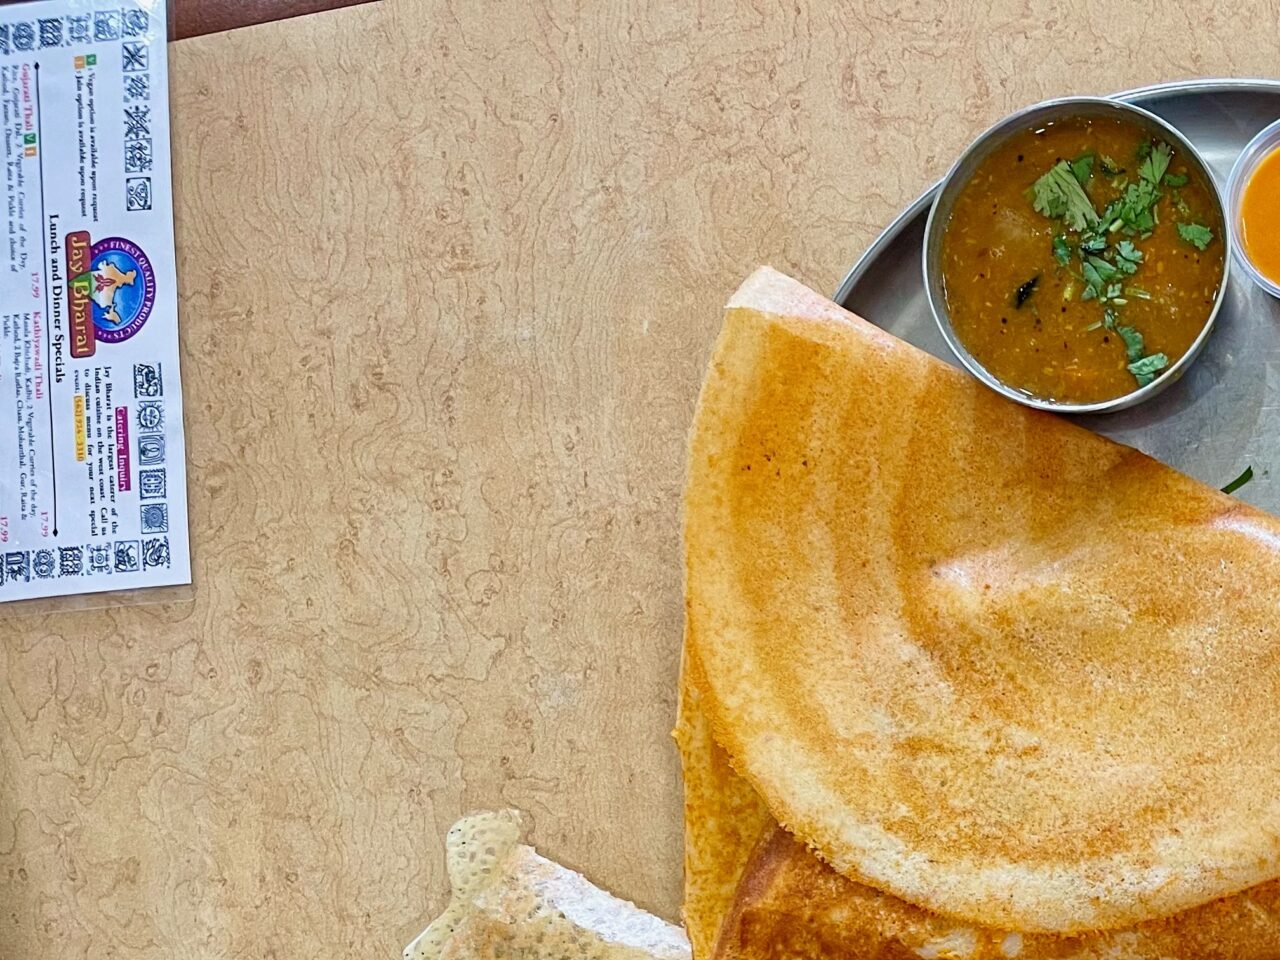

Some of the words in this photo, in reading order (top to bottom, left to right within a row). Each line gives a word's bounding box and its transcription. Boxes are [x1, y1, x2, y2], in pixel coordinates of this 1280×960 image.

[19, 64, 31, 102] Gujarati
[86, 73, 96, 96] Vegan
[24, 105, 33, 131] Thali
[75, 93, 84, 119] option
[87, 99, 96, 124] option
[90, 136, 98, 168] available
[89, 171, 97, 191] upon
[78, 189, 87, 216] request
[90, 194, 98, 222] request
[49, 215, 60, 254] Lunch
[68, 237, 88, 272] Jay
[111, 241, 141, 257] FINEST
[51, 258, 62, 281] and
[139, 257, 154, 299] QUALITY
[31, 273, 40, 298] 17.99
[52, 286, 64, 331] Dinner
[71, 281, 92, 352] Bharat
[112, 301, 153, 339] PRODUCTS
[31, 312, 43, 371] Kathiyawadi
[51, 335, 66, 383] Specials
[103, 366, 112, 378] Jay
[35, 373, 44, 399] Thali
[94, 368, 102, 394] Indian
[105, 383, 113, 410] Bharat
[95, 397, 103, 425] cuisine
[115, 407, 126, 449] Catering
[107, 444, 115, 470] largest
[86, 463, 94, 480] your
[117, 455, 128, 491] Inquiry
[40, 512, 49, 537] 17.99
[89, 510, 98, 536] special
[111, 508, 118, 517] of
[111, 522, 119, 534] the
